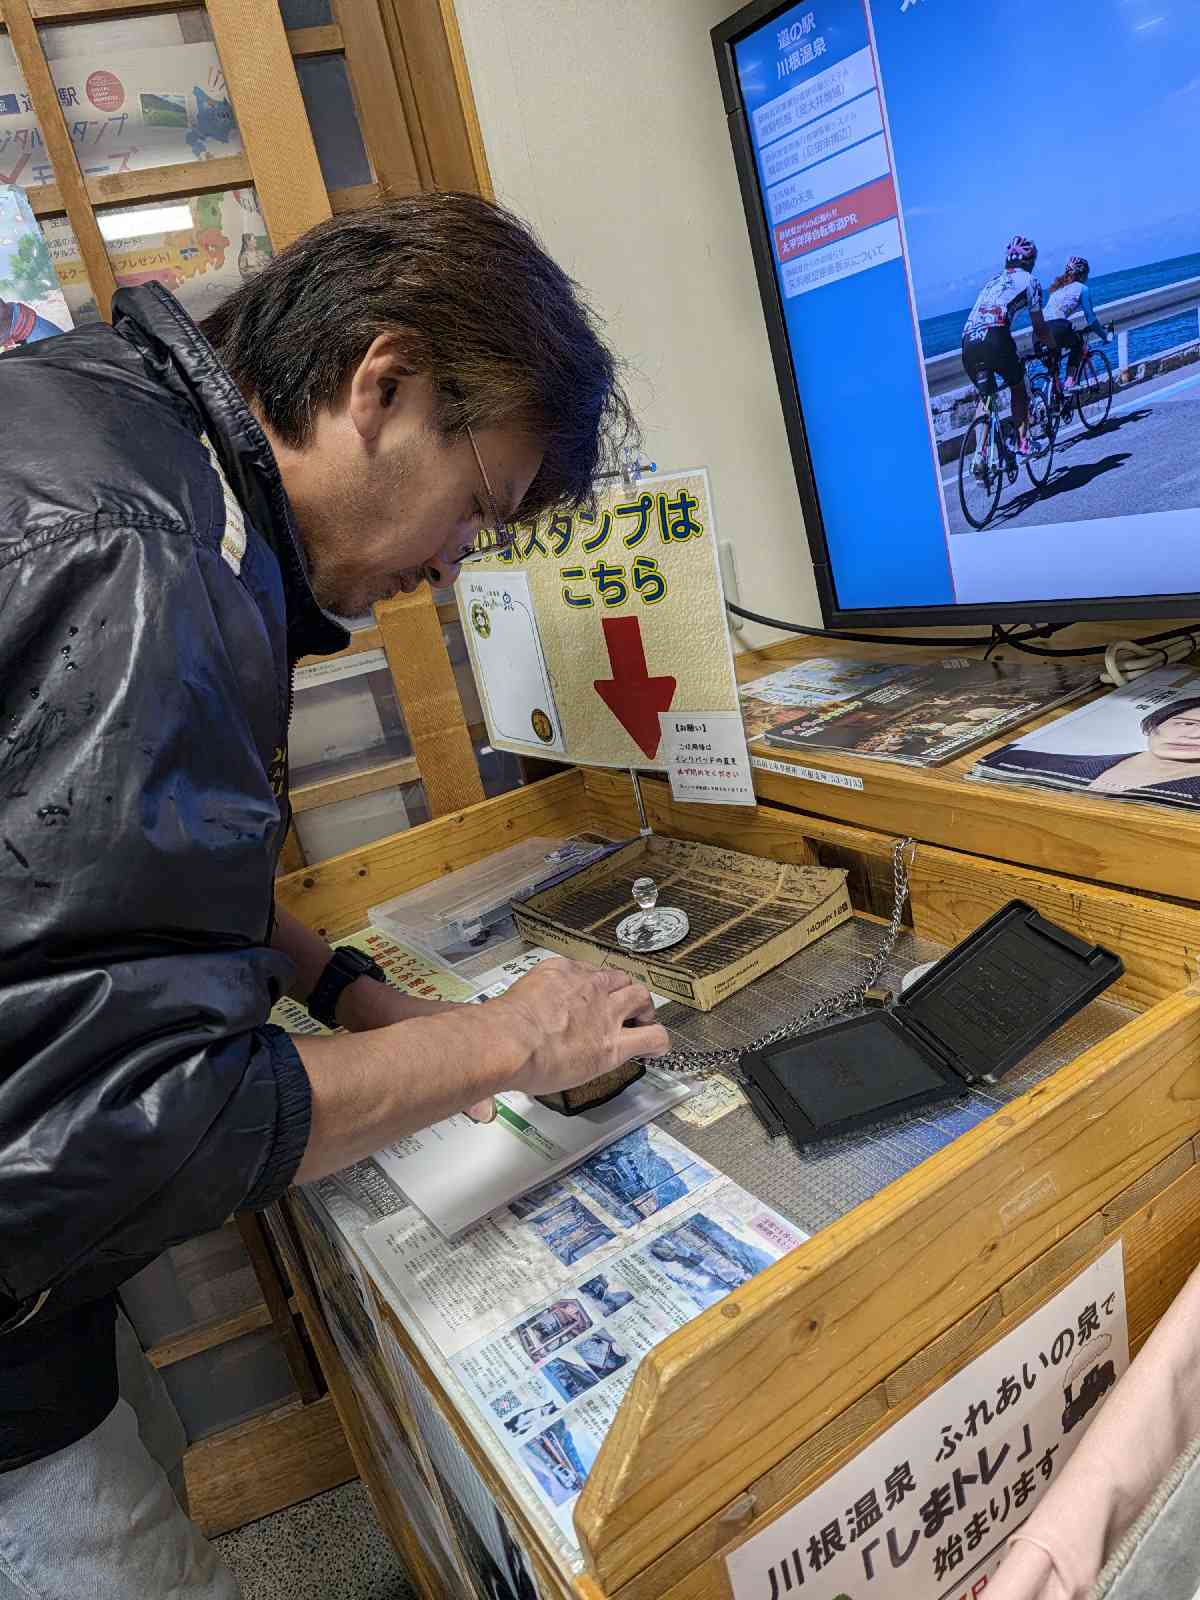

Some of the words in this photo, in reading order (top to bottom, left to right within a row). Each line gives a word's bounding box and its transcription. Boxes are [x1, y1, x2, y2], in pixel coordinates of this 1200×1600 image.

[776, 36, 827, 80] 川根温泉
[777, 12, 817, 49] 道の駅
[559, 555, 668, 608] こちら
[768, 1459, 917, 1600] 川根温泉
[935, 1290, 1116, 1464] ふれあいの泉で
[860, 1422, 1034, 1582] 「しまトレ」
[931, 1442, 1060, 1582] 始まります
